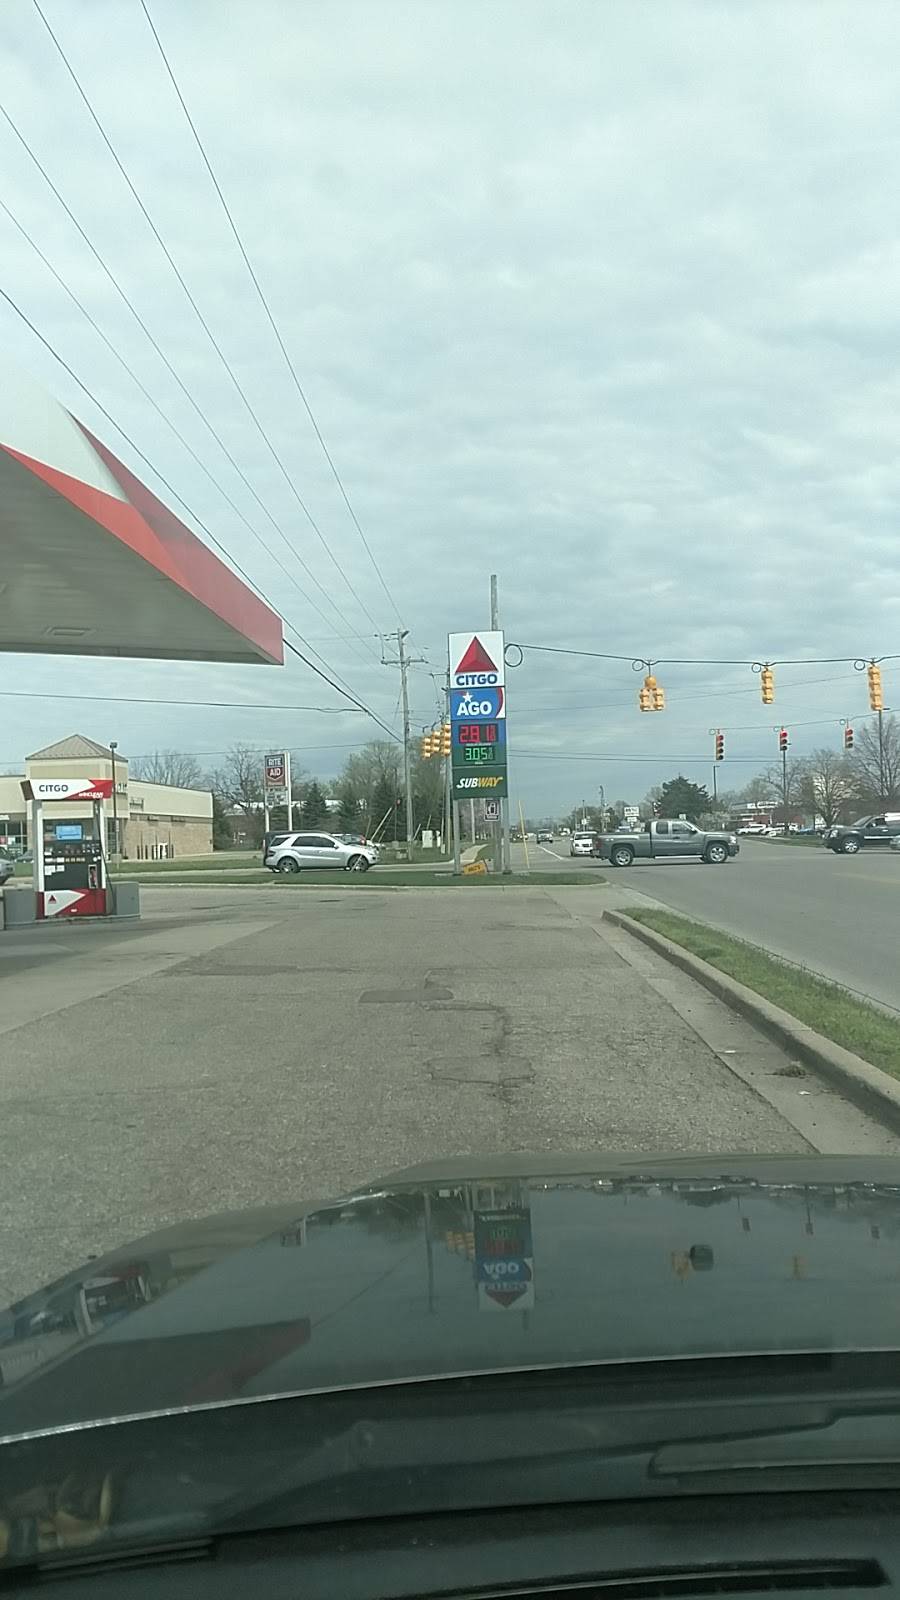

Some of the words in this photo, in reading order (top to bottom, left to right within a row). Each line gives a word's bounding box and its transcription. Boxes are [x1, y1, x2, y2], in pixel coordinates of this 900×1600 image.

[456, 673, 498, 686] CITGO
[457, 701, 492, 716] AGO
[268, 758, 283, 767] RITE
[269, 767, 281, 777] AID
[39, 784, 69, 792] CITGO
[456, 776, 503, 789] SUBWAY
